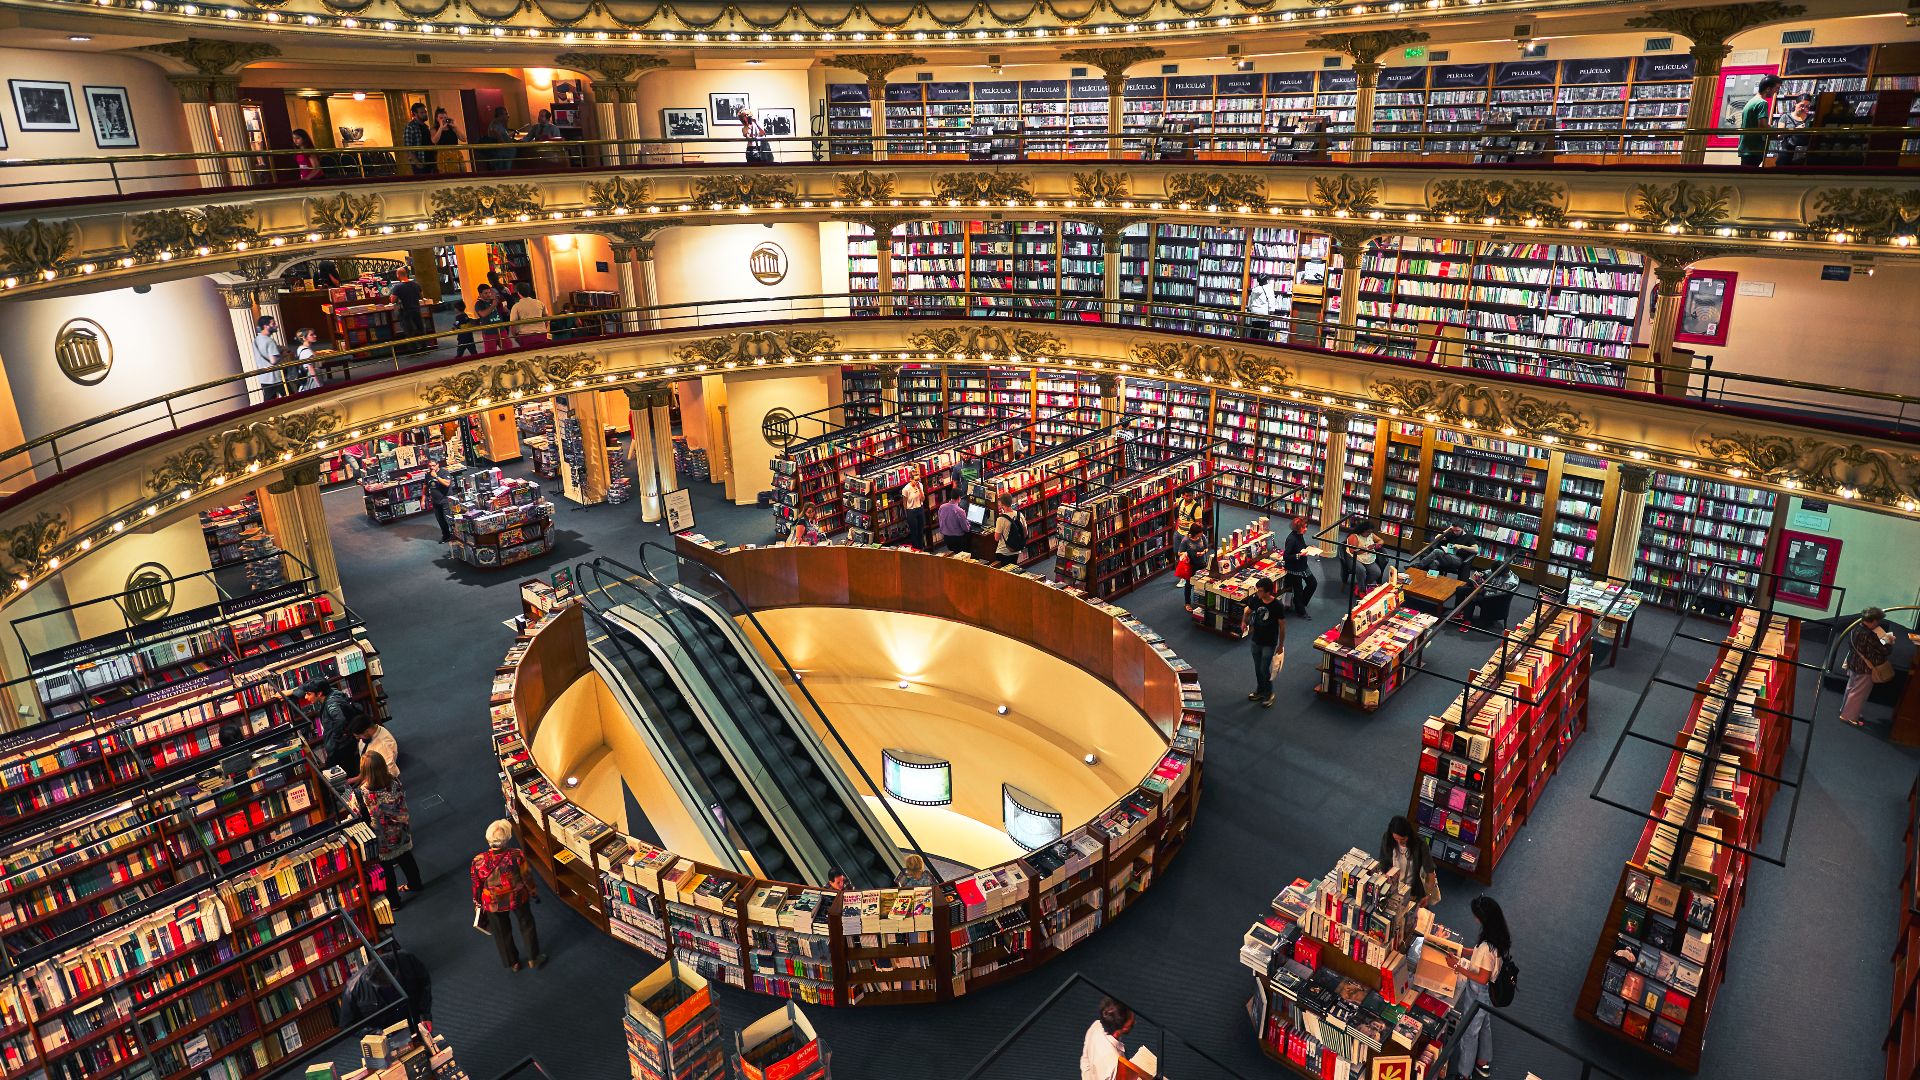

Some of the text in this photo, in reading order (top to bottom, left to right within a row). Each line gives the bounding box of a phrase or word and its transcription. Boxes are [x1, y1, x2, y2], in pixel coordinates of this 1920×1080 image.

[1807, 56, 1847, 65] PELÍCULAS
[1654, 63, 1688, 71] PELÍCULAS
[1511, 69, 1541, 77] PELÍCULAS
[1126, 83, 1157, 91] PELÍCULAS
[1175, 82, 1206, 90] PELÍCULAS
[280, 646, 304, 658] TEMAS
[253, 836, 303, 861] HISTORIA
[90, 904, 150, 933] HISTORIA
